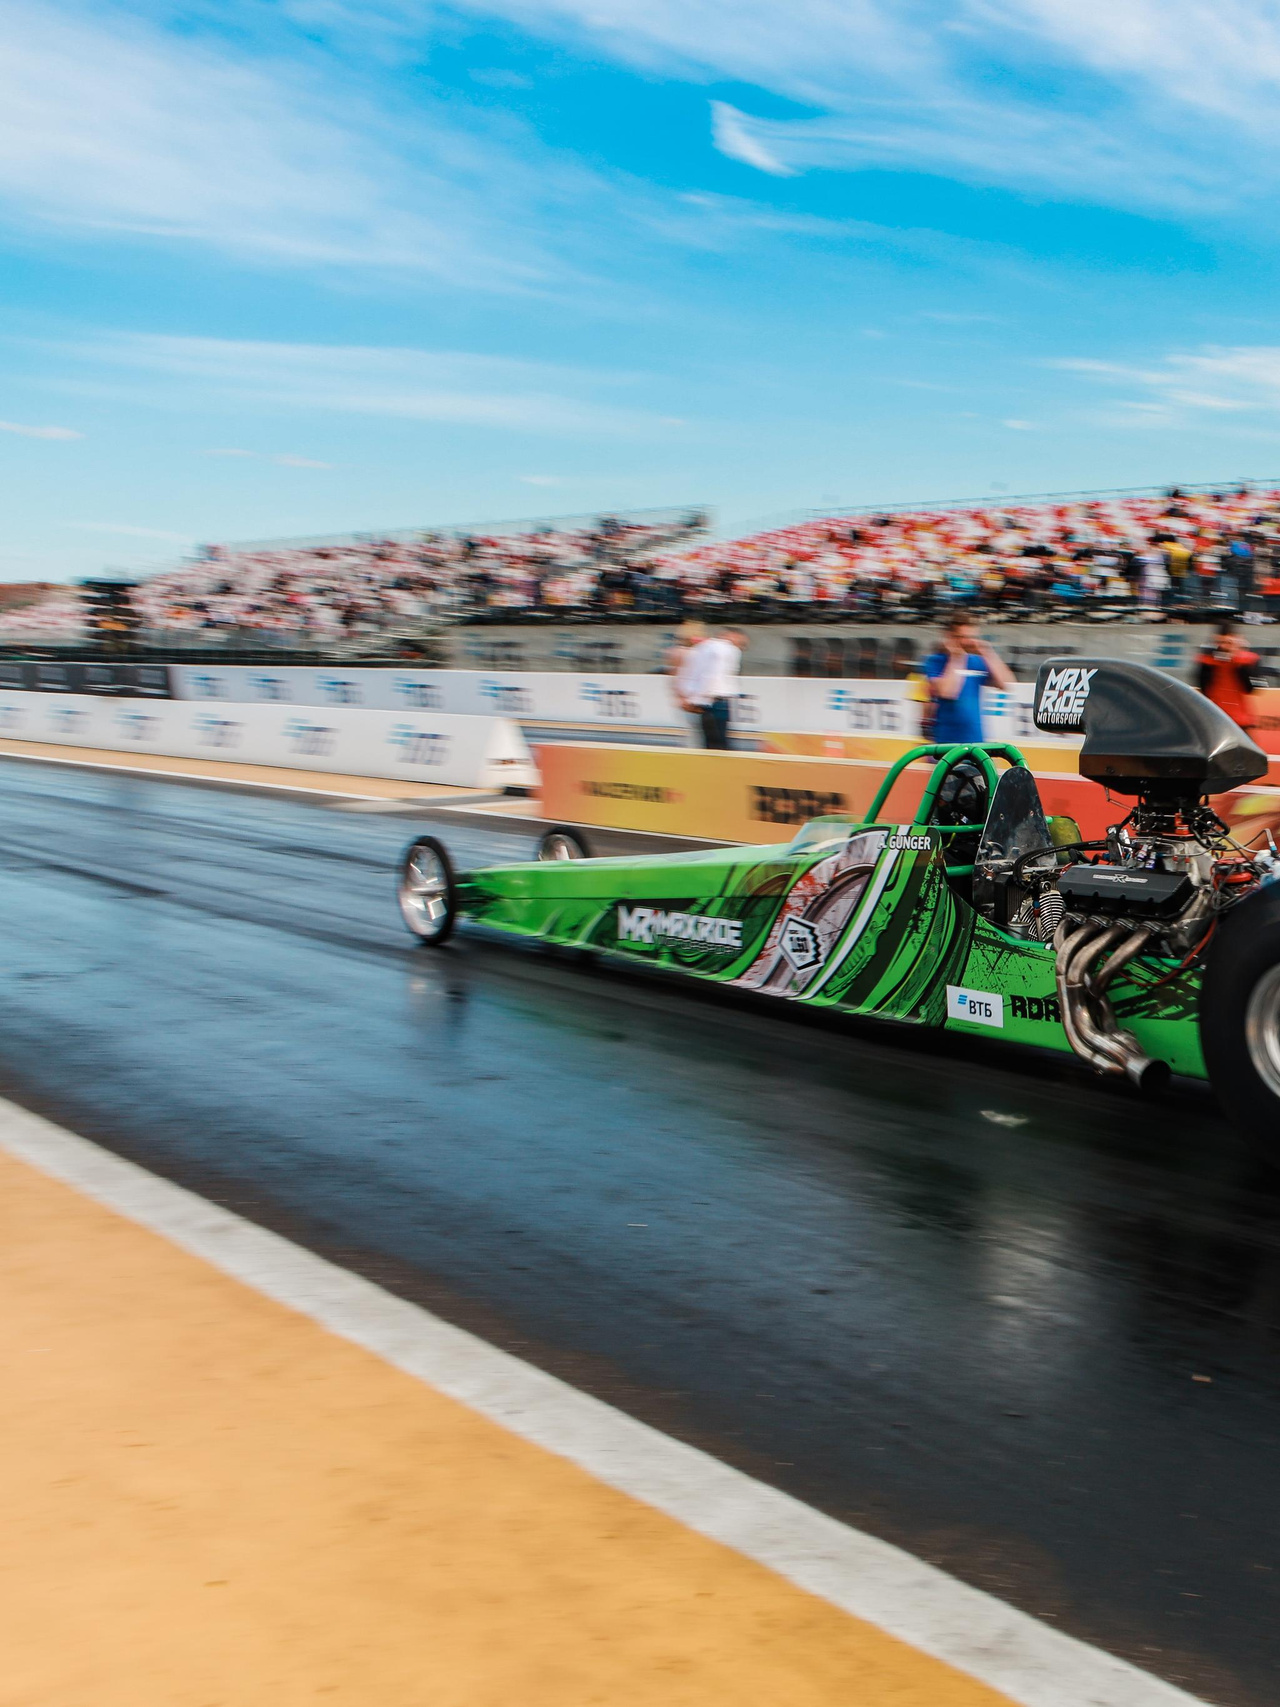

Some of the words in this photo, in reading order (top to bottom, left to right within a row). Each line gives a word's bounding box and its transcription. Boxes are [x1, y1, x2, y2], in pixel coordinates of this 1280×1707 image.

[1044, 668, 1098, 691] MAX
[1039, 690, 1089, 713] RIDE
[1037, 711, 1081, 725] MOTORSPORT
[889, 835, 931, 850] GUNGER
[969, 999, 992, 1018] ВТБ
[1010, 994, 1061, 1023] RDR
